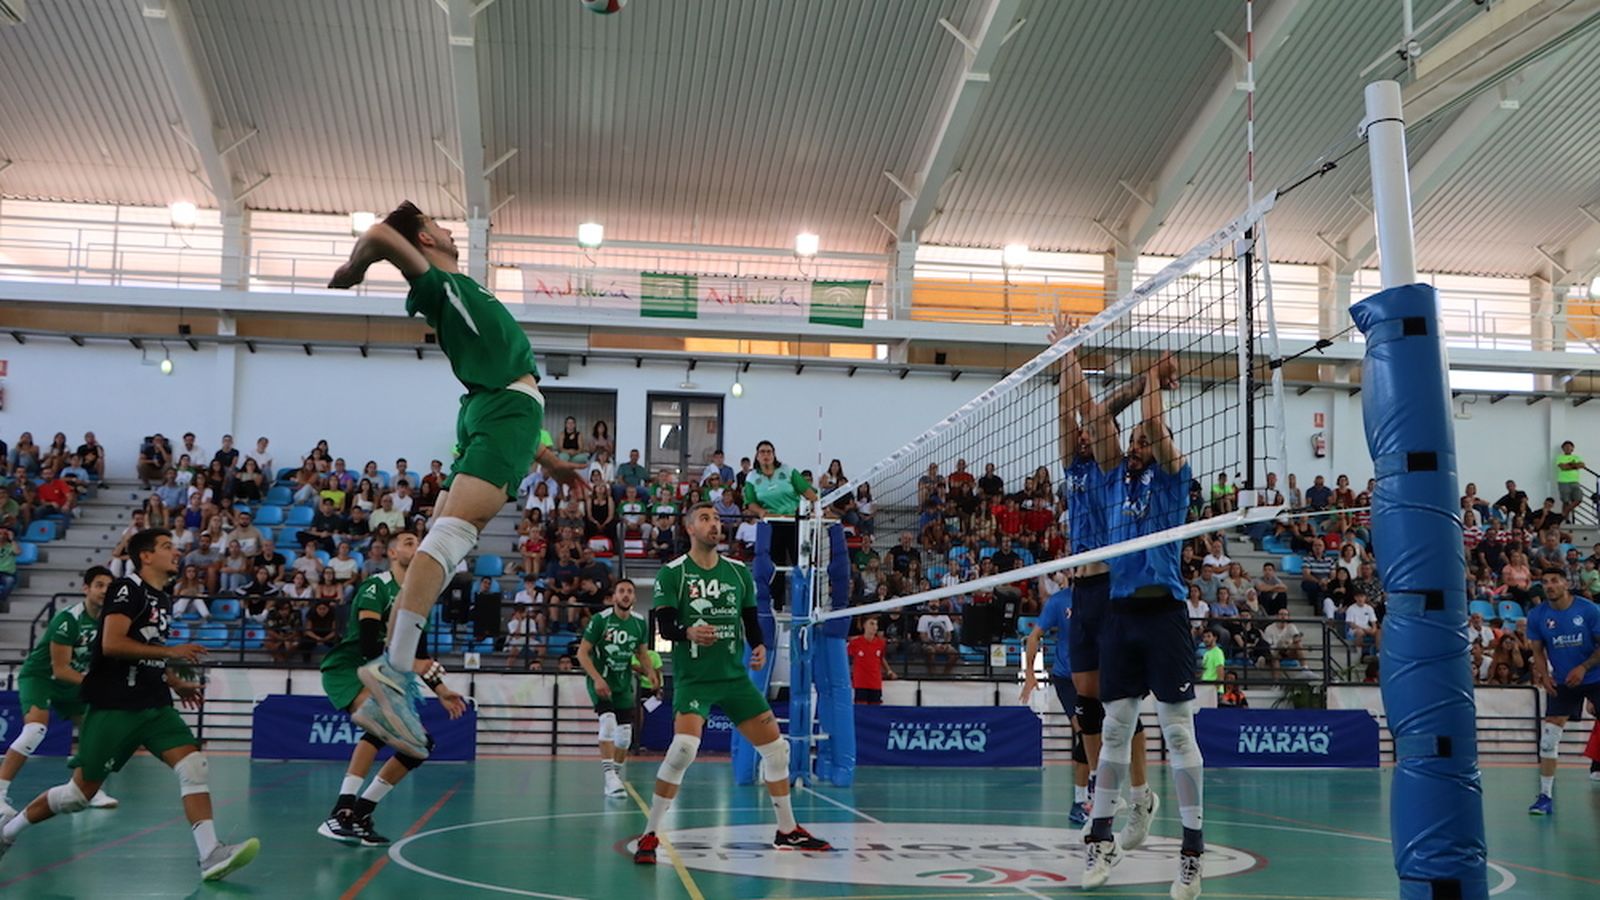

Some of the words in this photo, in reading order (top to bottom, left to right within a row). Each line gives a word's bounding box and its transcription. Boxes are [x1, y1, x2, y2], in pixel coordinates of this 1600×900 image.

[697, 579, 721, 598] 14
[612, 630, 628, 645] 10
[313, 714, 347, 722] TABL
[707, 719, 736, 731] Depo
[890, 722, 931, 730] TABLE
[939, 722, 987, 730] TENNIS
[887, 729, 987, 753] NARAQ
[1238, 732, 1330, 755] NARAQ
